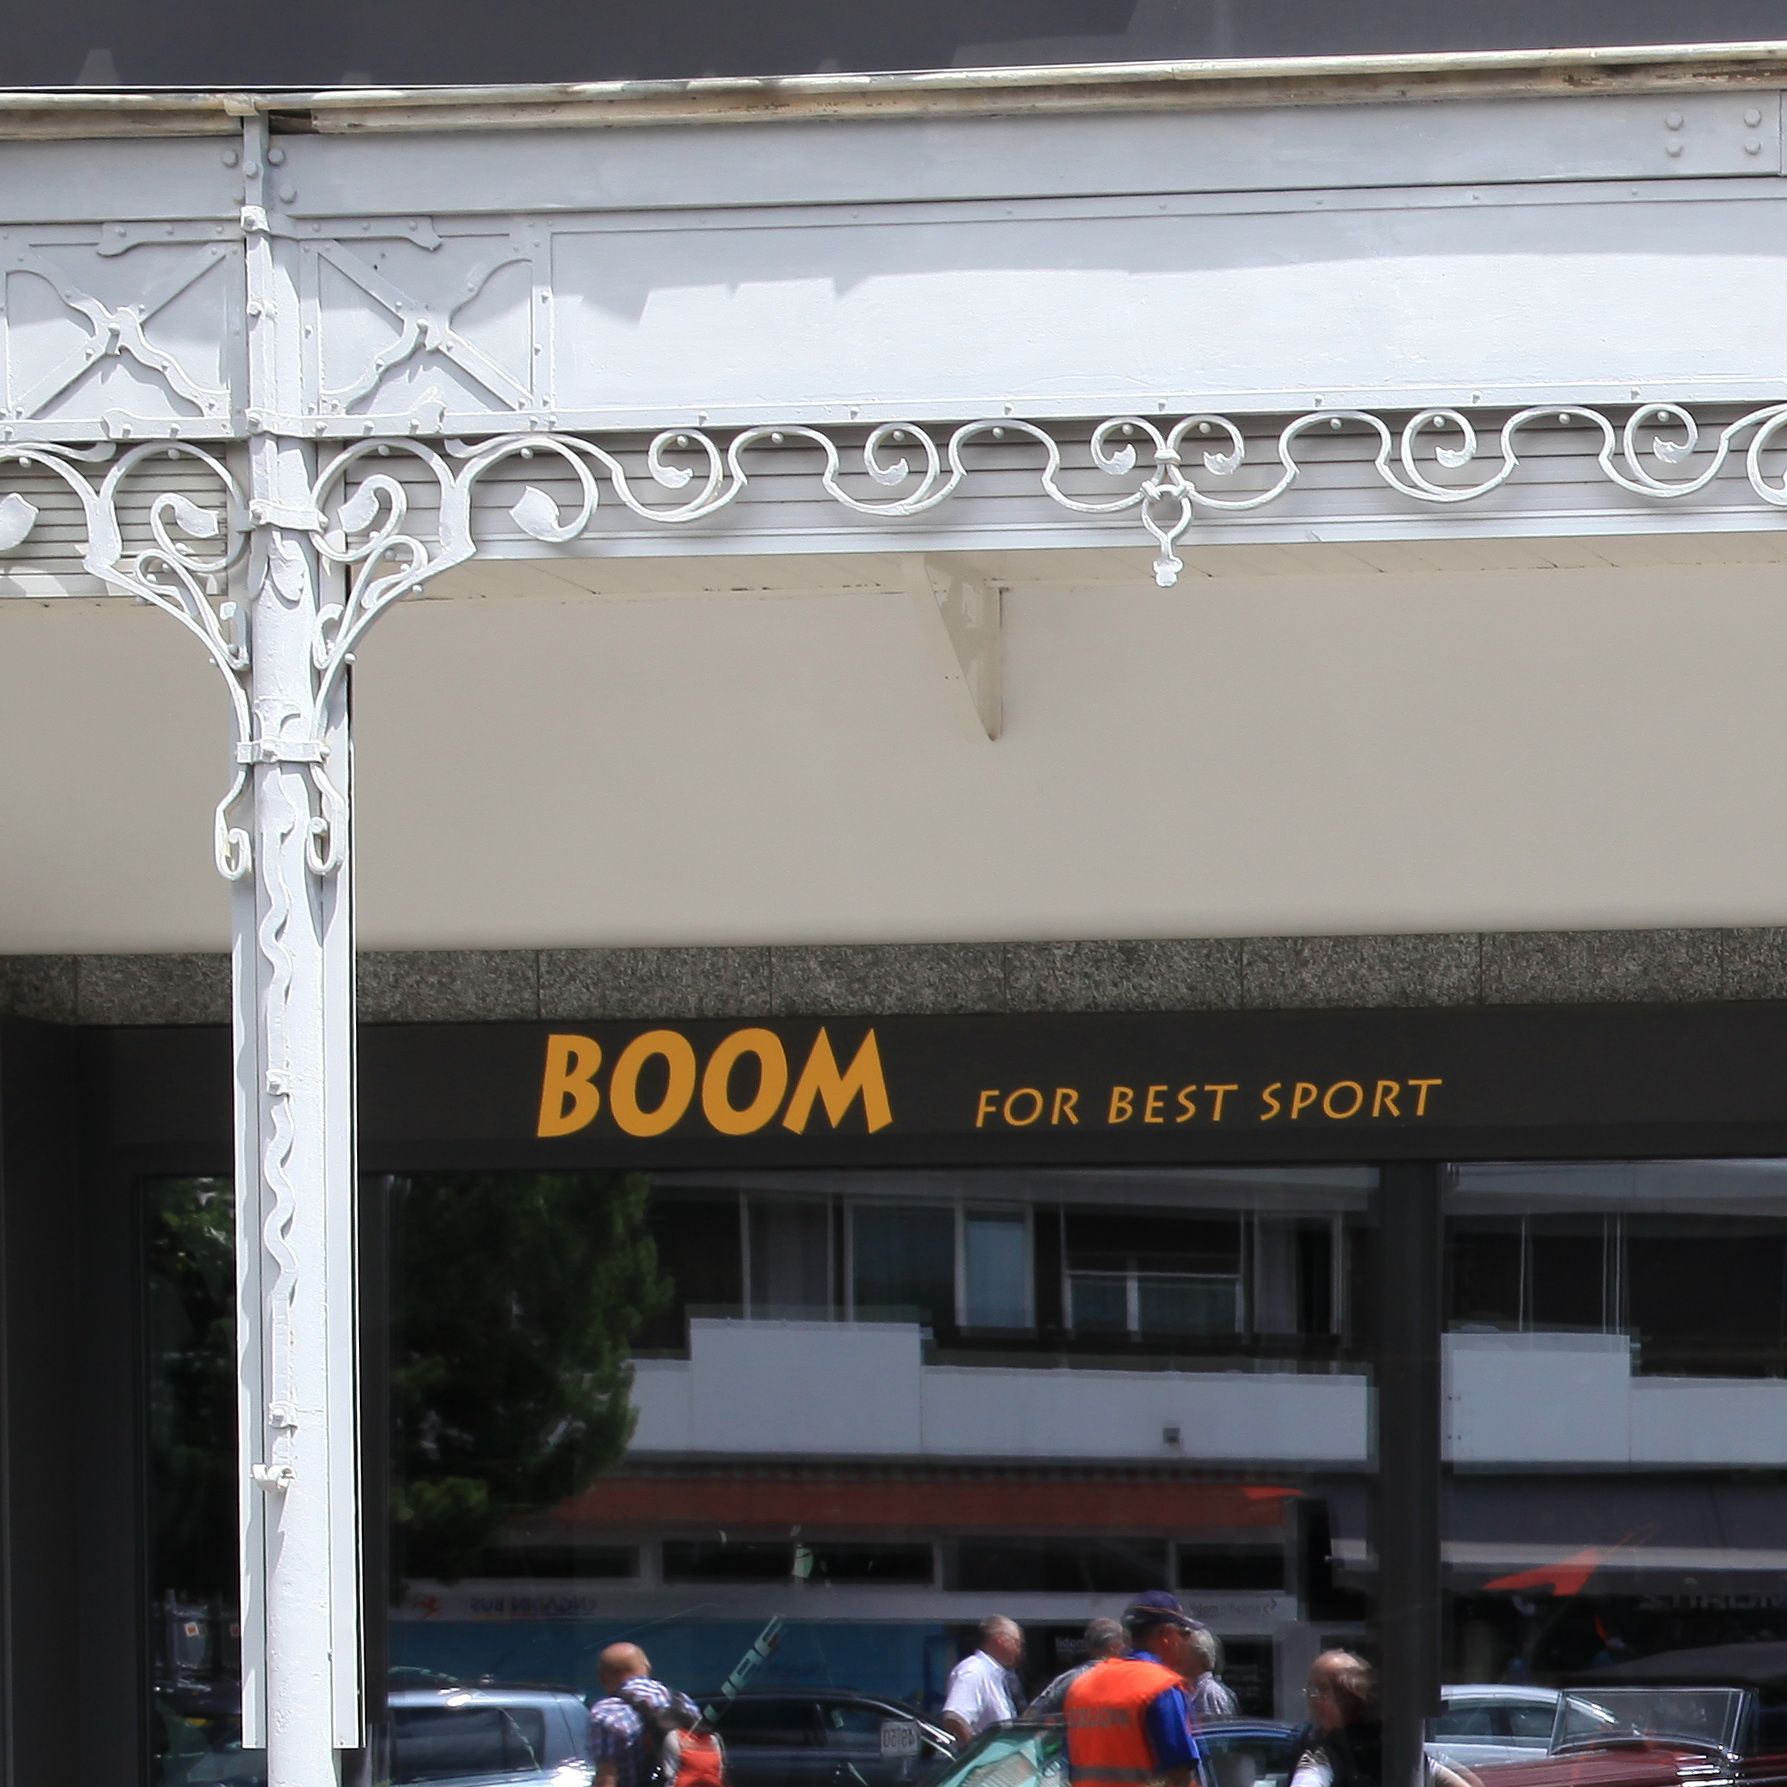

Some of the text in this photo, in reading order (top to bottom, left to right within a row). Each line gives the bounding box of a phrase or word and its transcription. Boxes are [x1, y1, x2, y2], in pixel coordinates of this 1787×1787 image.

[536, 1027, 893, 1137] BOOM
[975, 1078, 1444, 1128] FOR BEST SPORT
